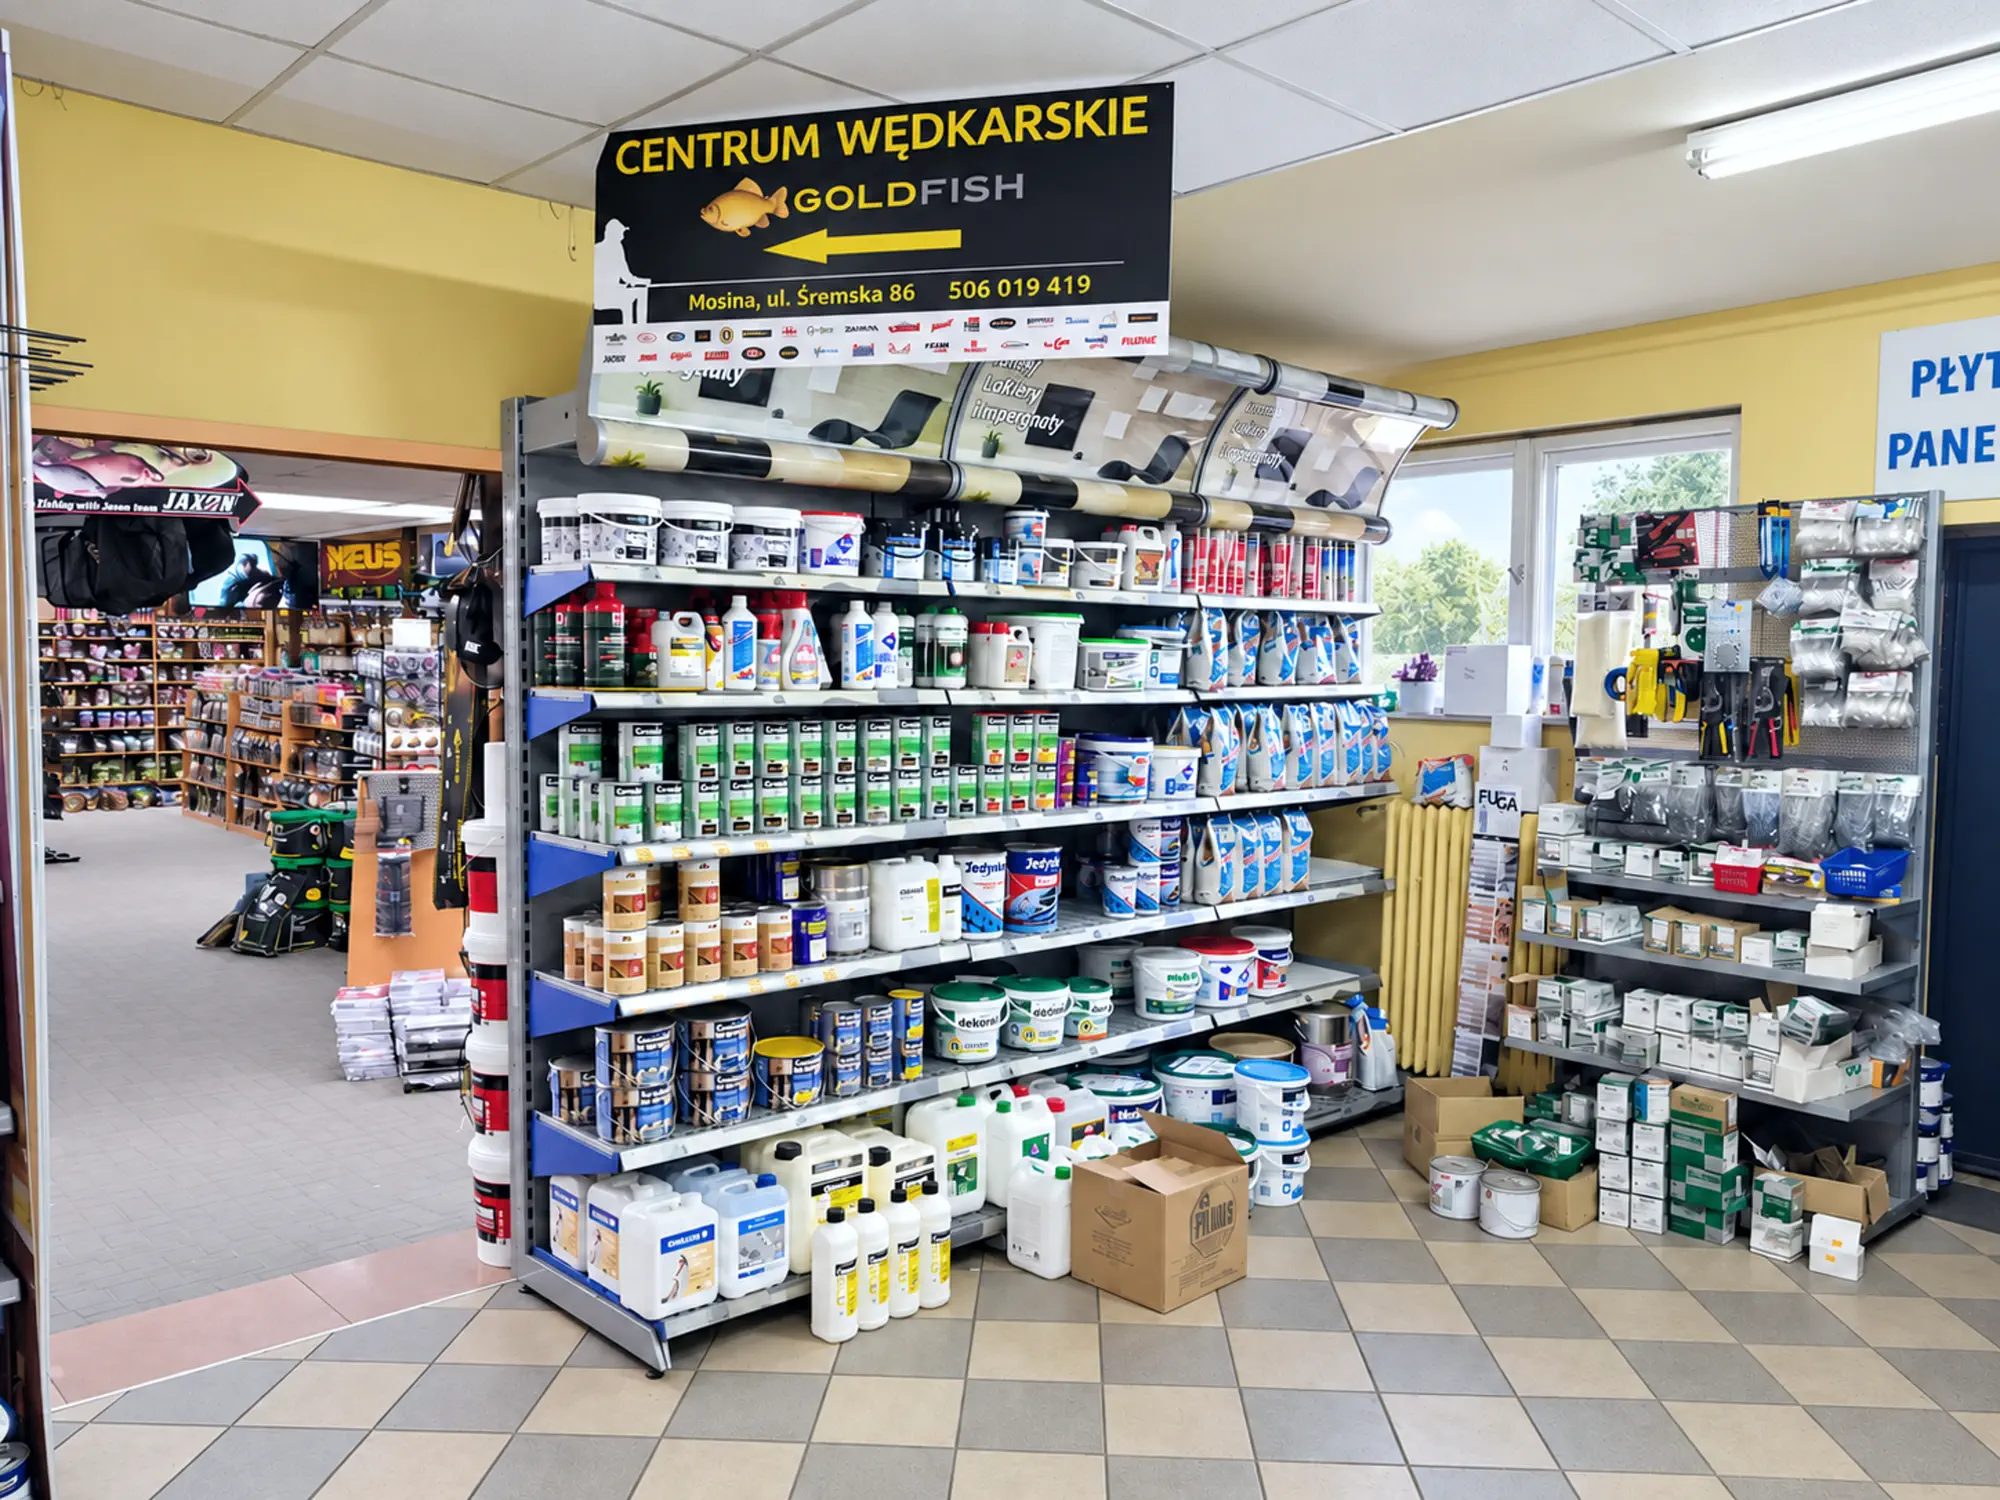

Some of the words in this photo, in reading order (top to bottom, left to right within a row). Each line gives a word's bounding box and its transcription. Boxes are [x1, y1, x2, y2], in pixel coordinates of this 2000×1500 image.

[615, 123, 820, 176] CENTRUM
[836, 95, 1148, 161] WĘDKARSKIE
[793, 173, 1024, 213] GOLDFISH
[688, 293, 761, 312] Mosina,
[766, 289, 791, 308] ul.
[797, 285, 883, 307] Śremska
[889, 283, 916, 302] 86
[948, 280, 991, 301] 506
[996, 277, 1040, 298] 019
[1047, 275, 1092, 297] 419
[1888, 424, 1996, 470] PANE
[162, 491, 239, 514] JAXON
[1478, 788, 1519, 812] FUGA
